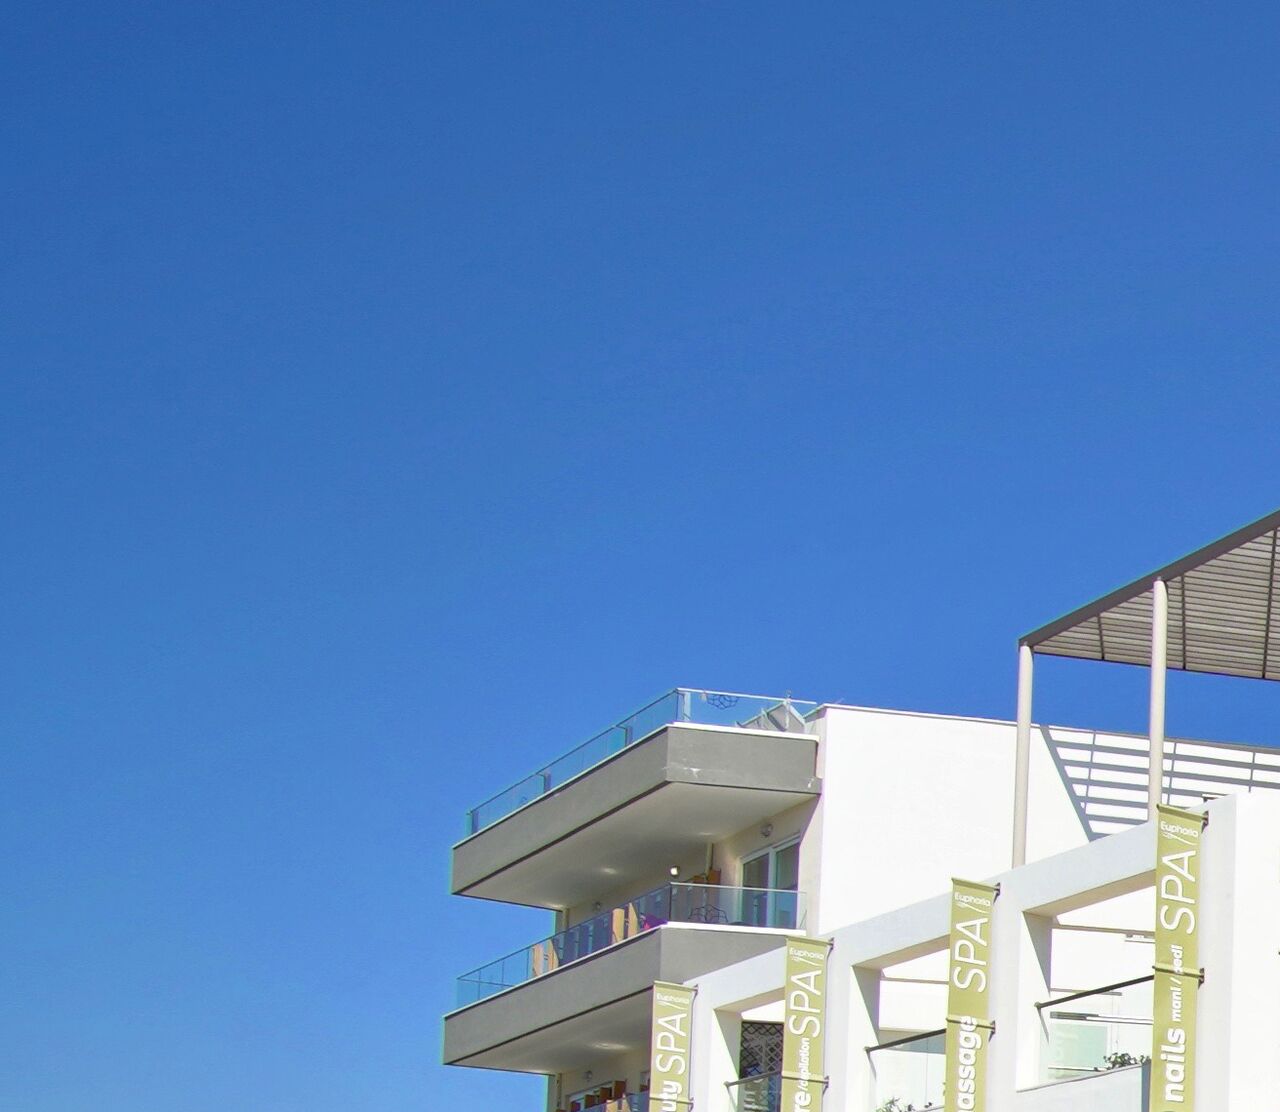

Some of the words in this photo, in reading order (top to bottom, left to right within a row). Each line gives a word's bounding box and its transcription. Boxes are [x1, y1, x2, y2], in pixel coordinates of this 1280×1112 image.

[1161, 821, 1198, 838] Euphoria
[1160, 850, 1196, 935] SPA
[953, 918, 988, 993] SPA
[788, 969, 822, 1038] SPA
[1170, 987, 1183, 1022] mani
[656, 1013, 687, 1075] SPA
[1161, 1028, 1186, 1103] nails
